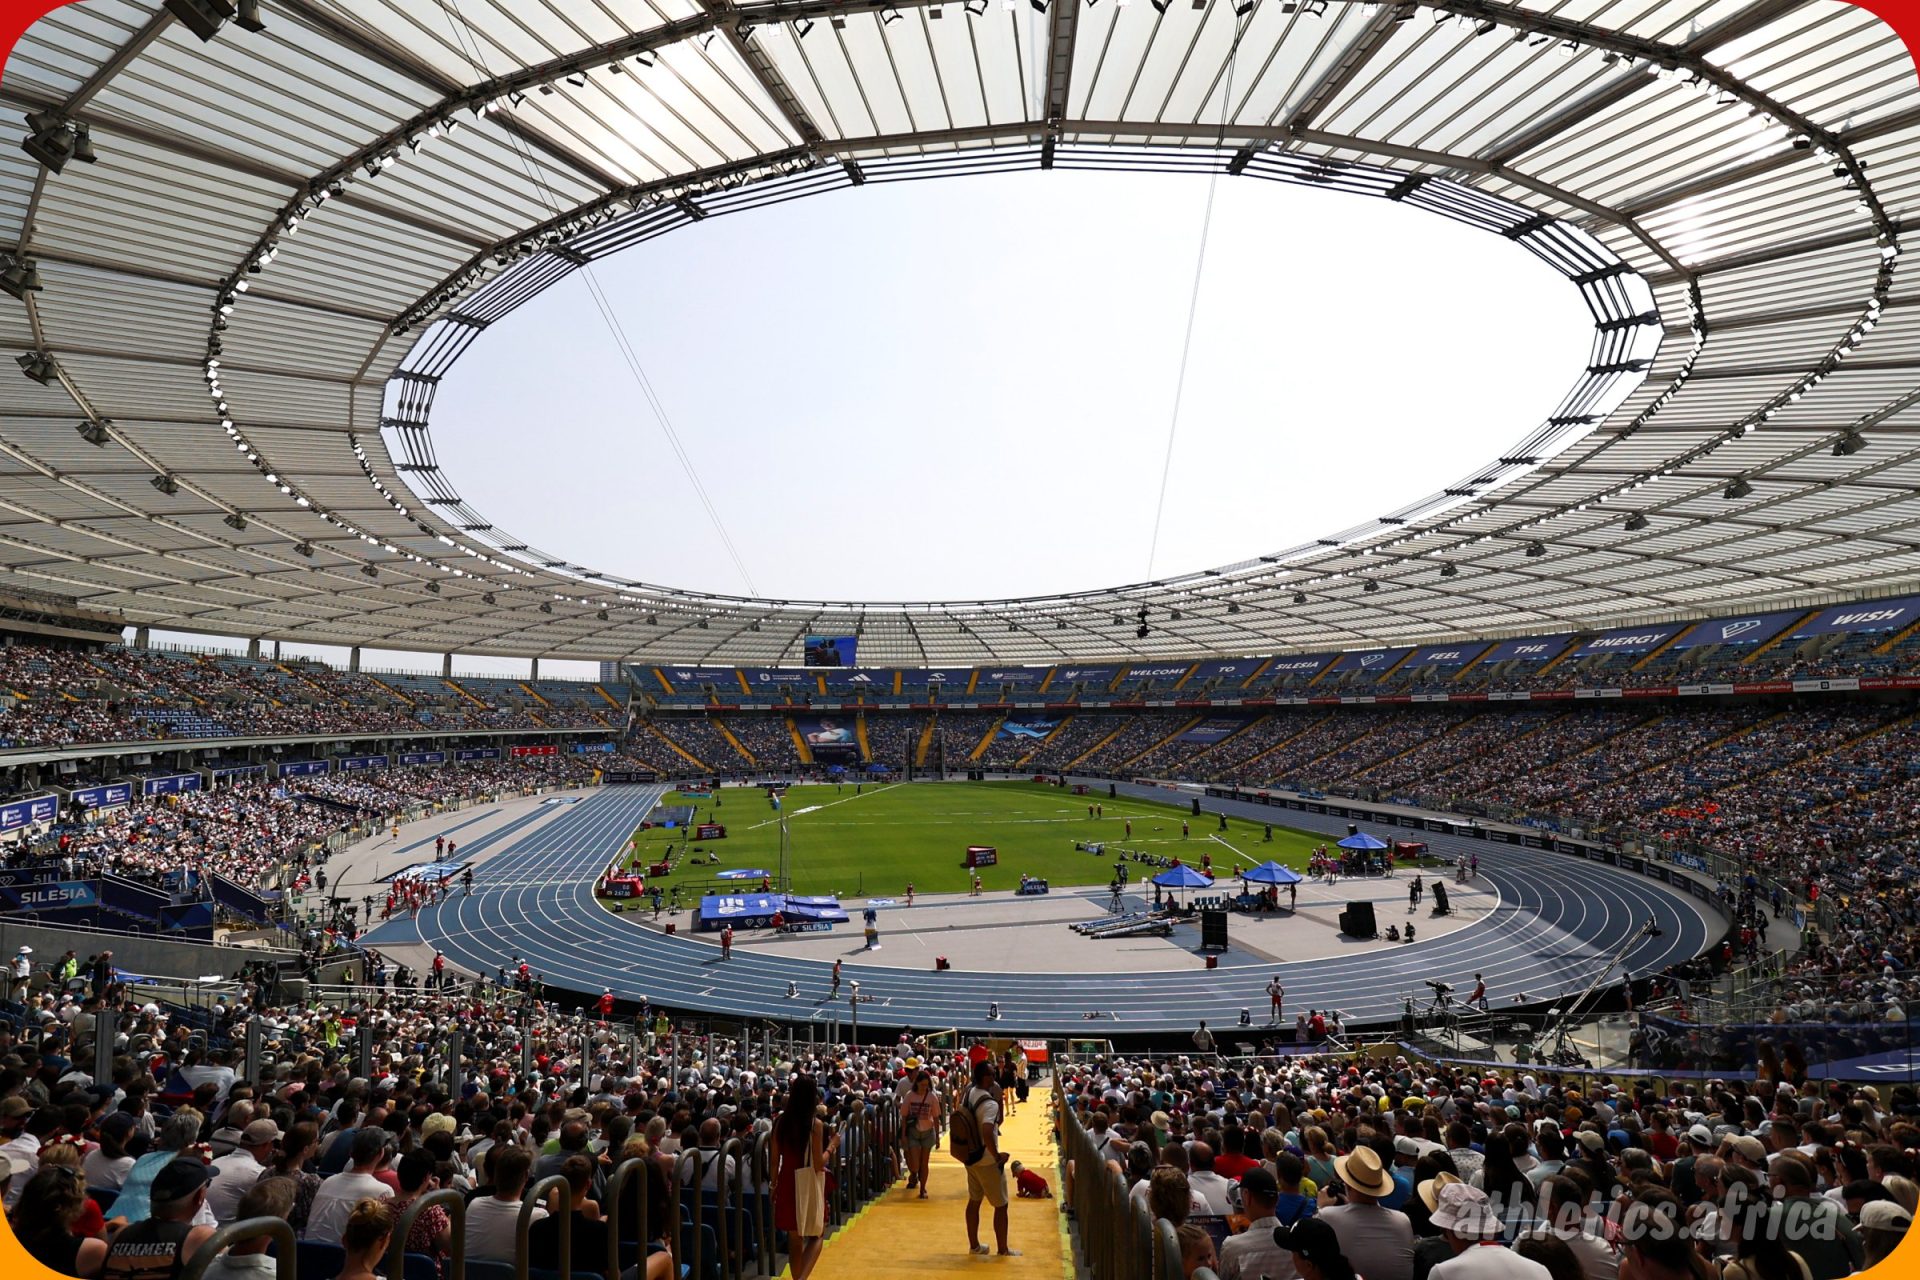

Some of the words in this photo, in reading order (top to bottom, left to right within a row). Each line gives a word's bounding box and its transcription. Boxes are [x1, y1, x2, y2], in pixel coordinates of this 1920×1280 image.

[1831, 608, 1905, 626] WISH
[1588, 633, 1668, 649] ENERGY
[1514, 644, 1548, 654] THE
[1427, 651, 1460, 660] FEEL
[1275, 661, 1319, 670] SILESIA
[1129, 667, 1187, 677] WELCOME
[20, 887, 88, 904] SILESIA
[802, 923, 829, 931] SILESIA
[1480, 1000, 1487, 1009] 8
[1242, 1013, 1248, 1022] 7
[111, 1242, 177, 1256] SUMMER
